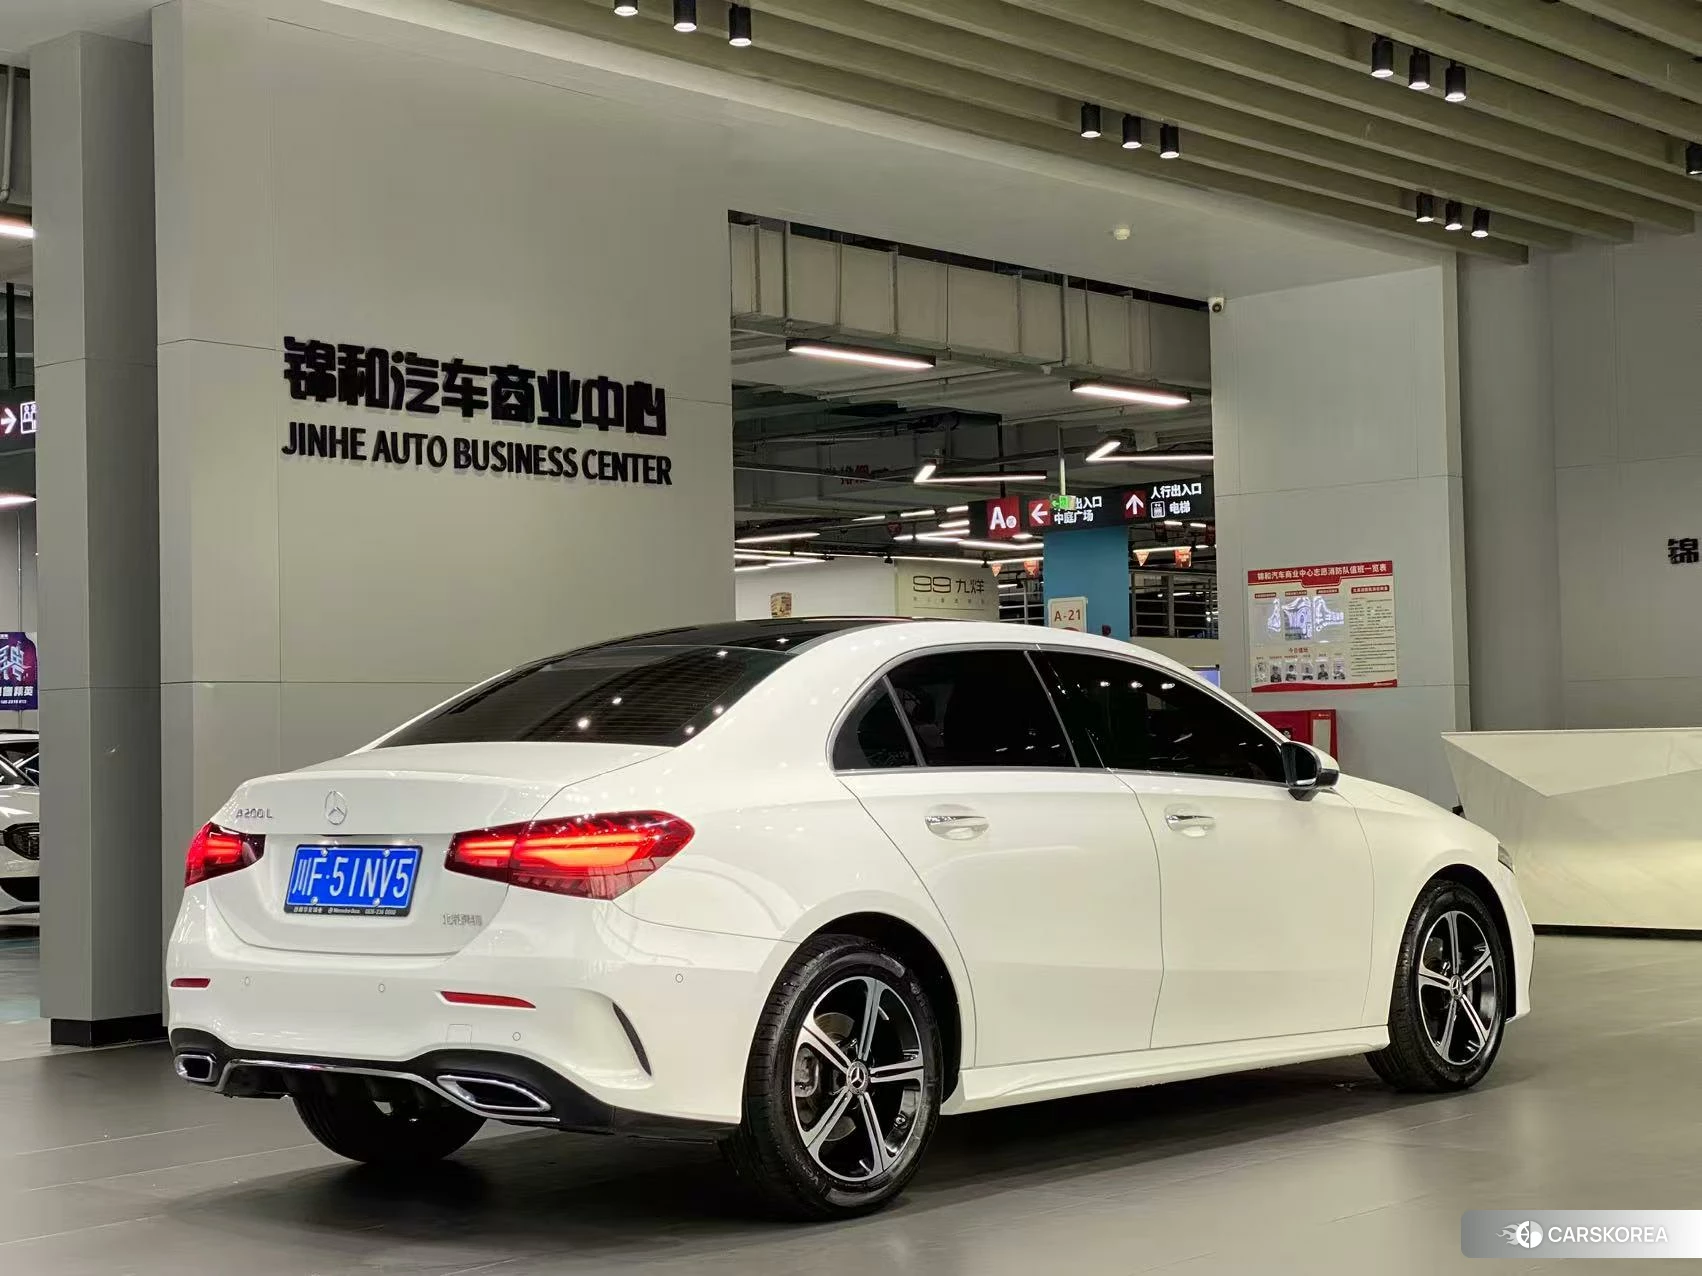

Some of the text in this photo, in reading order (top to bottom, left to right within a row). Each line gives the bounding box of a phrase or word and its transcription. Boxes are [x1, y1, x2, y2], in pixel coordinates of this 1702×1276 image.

[283, 336, 667, 437] 锦和汽车商业中心
[281, 421, 672, 485] JINHE AUTO BUSINESS CENTER
[1150, 482, 1202, 499] 人行出入口
[1169, 500, 1191, 514] 电梯
[1053, 510, 1094, 524] 中庭广场
[1667, 537, 1700, 565] 锦
[1054, 609, 1081, 622] A-21
